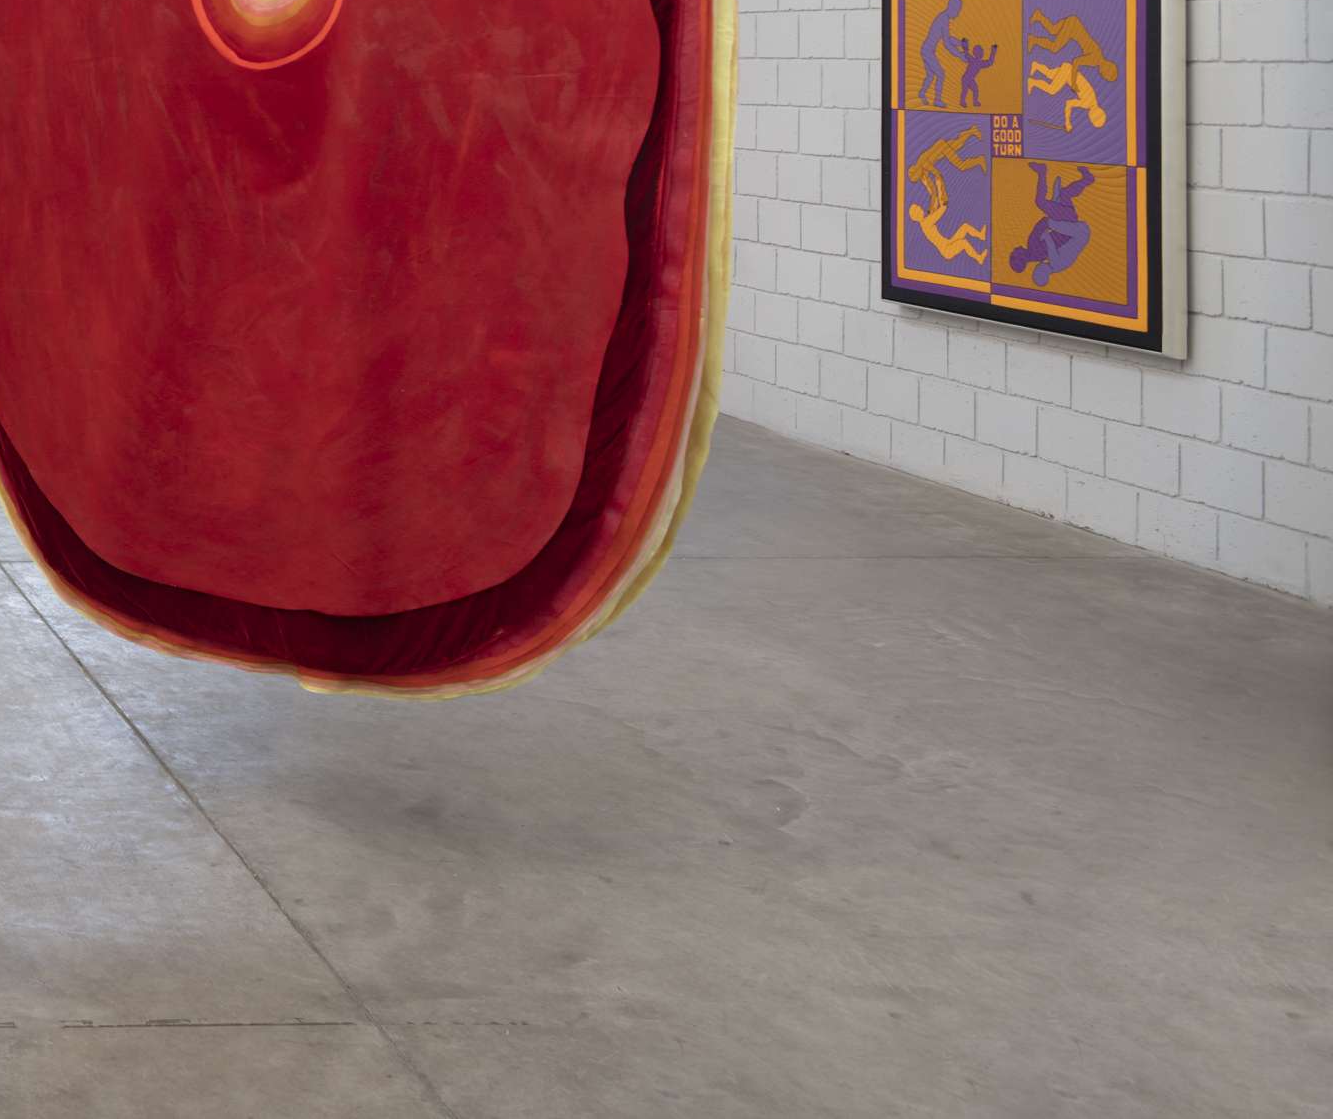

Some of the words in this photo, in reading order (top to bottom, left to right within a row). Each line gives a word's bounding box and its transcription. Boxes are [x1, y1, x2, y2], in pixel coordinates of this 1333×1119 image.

[993, 115, 1008, 128] DO
[1012, 115, 1019, 128] A
[993, 129, 1022, 143] GOOD
[993, 143, 1022, 157] TURN
